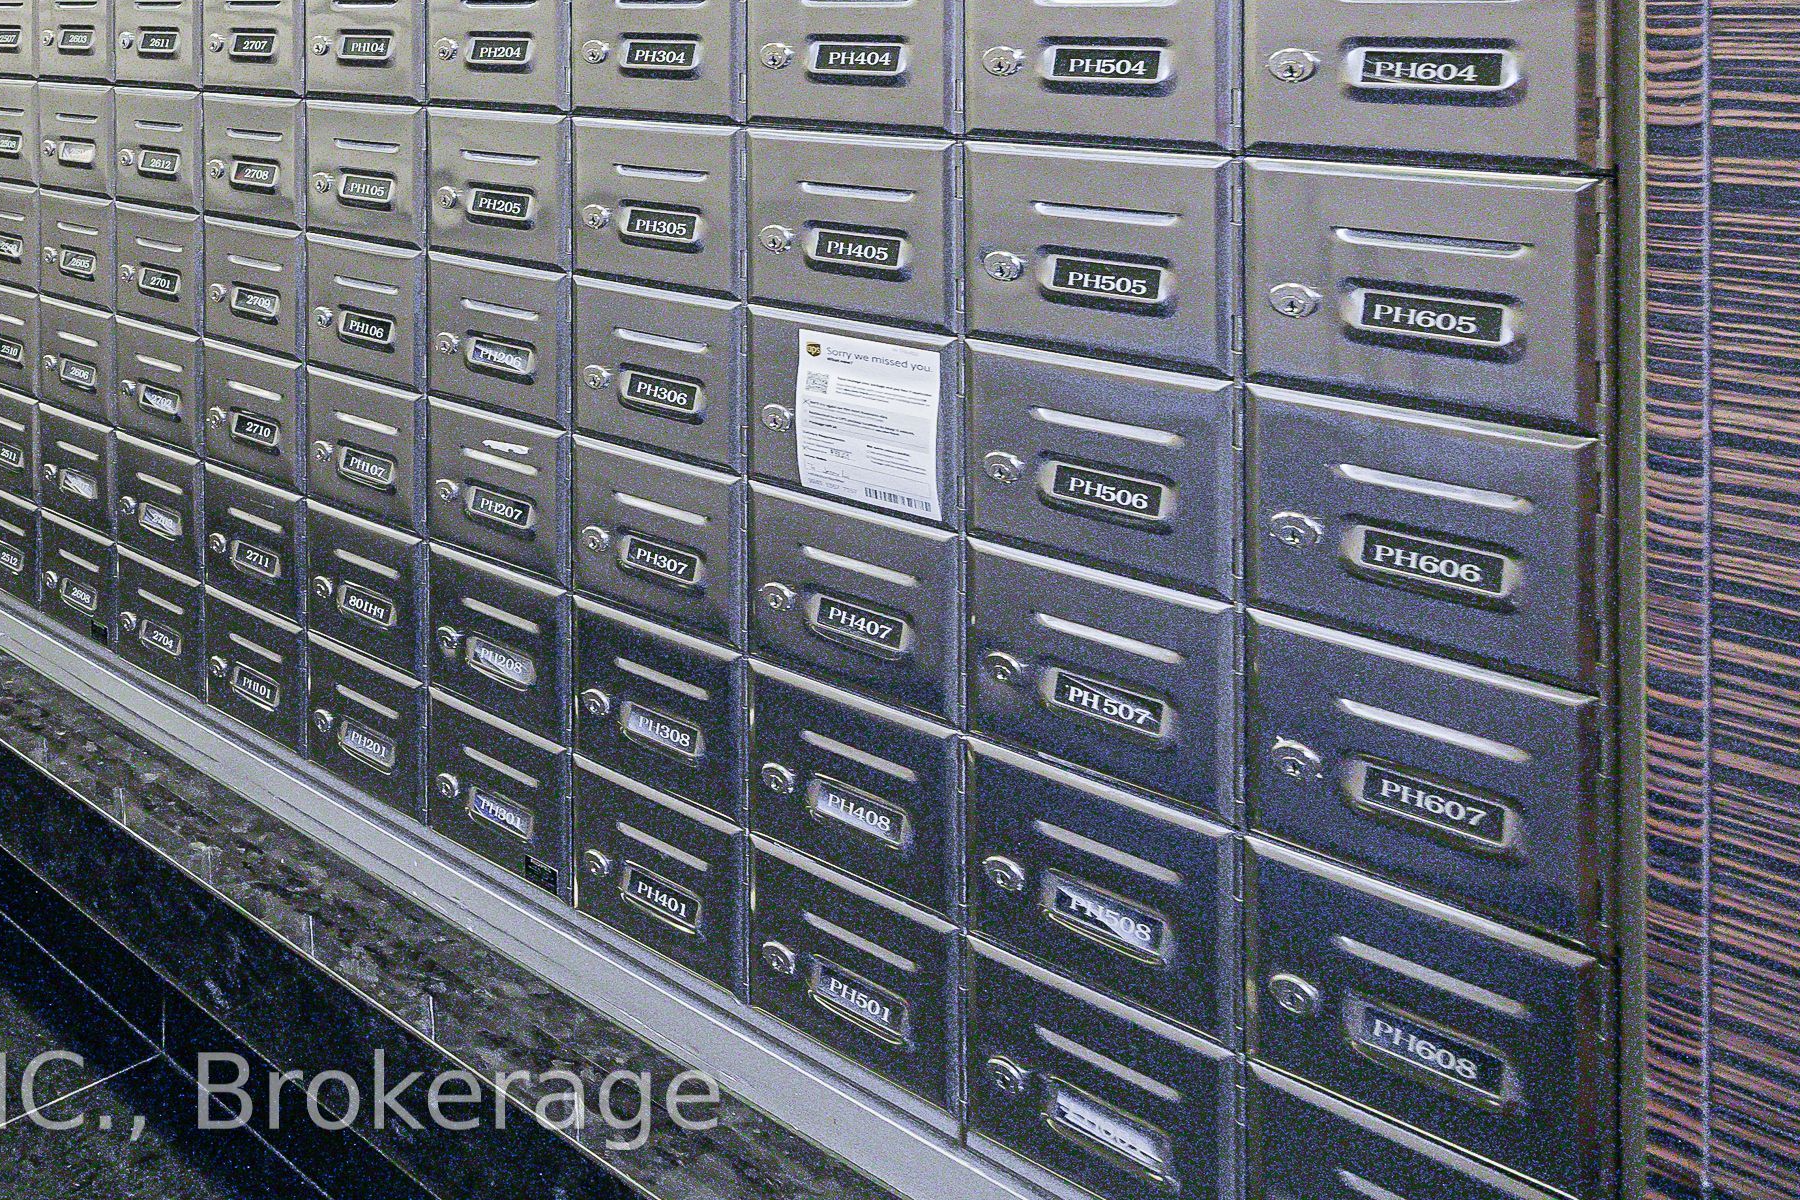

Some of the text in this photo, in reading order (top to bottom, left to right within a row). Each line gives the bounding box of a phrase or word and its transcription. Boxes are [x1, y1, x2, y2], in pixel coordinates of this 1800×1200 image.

[0, 34, 16, 43] 2507
[68, 34, 87, 43] 2603
[150, 38, 170, 47] 2611
[243, 40, 268, 50] 2707
[351, 42, 385, 53] PH104
[479, 47, 522, 58] PH204
[634, 49, 686, 64] PH304
[827, 51, 891, 66] PH404
[1068, 58, 1148, 75] PH504
[1374, 61, 1478, 82] PH604
[150, 157, 172, 170] 2612
[244, 168, 269, 181] 2708
[349, 182, 384, 197] PH105
[478, 198, 521, 214] PH205
[635, 218, 686, 236] PH305
[826, 240, 889, 261] PH405
[71, 257, 90, 269] 2605
[150, 276, 171, 289] 2701
[1067, 271, 1147, 295] PH505
[246, 294, 271, 309] 2709
[349, 319, 384, 338] PH106
[1374, 304, 1477, 334] PH605
[1, 344, 18, 357] 2510
[479, 348, 522, 368] PH206
[826, 346, 933, 374] Sorry we missed you.
[70, 366, 89, 380] 2606
[636, 381, 687, 406] PH306
[245, 421, 271, 438] 2710
[0, 447, 17, 462] 2511
[350, 456, 386, 478] PH107
[1068, 476, 1149, 510] PH506
[480, 497, 523, 520] PH207
[1, 551, 18, 566] 2512
[246, 549, 270, 568] 2711
[636, 548, 688, 575] PH307
[1374, 543, 1480, 584] PH606
[71, 586, 91, 604] 2608
[828, 606, 892, 639] PH407
[152, 630, 174, 649] 2704
[481, 647, 523, 674] PH208
[1068, 686, 1153, 725] PH507
[638, 714, 691, 747] PH308
[350, 730, 387, 758] PH201
[480, 794, 523, 828] PH301
[827, 793, 892, 832] PH408
[1380, 779, 1487, 827] PH607
[637, 881, 688, 918] PH401
[1069, 894, 1152, 944] PH508
[829, 977, 892, 1023] PH501
[1373, 1018, 1479, 1080] PH608
